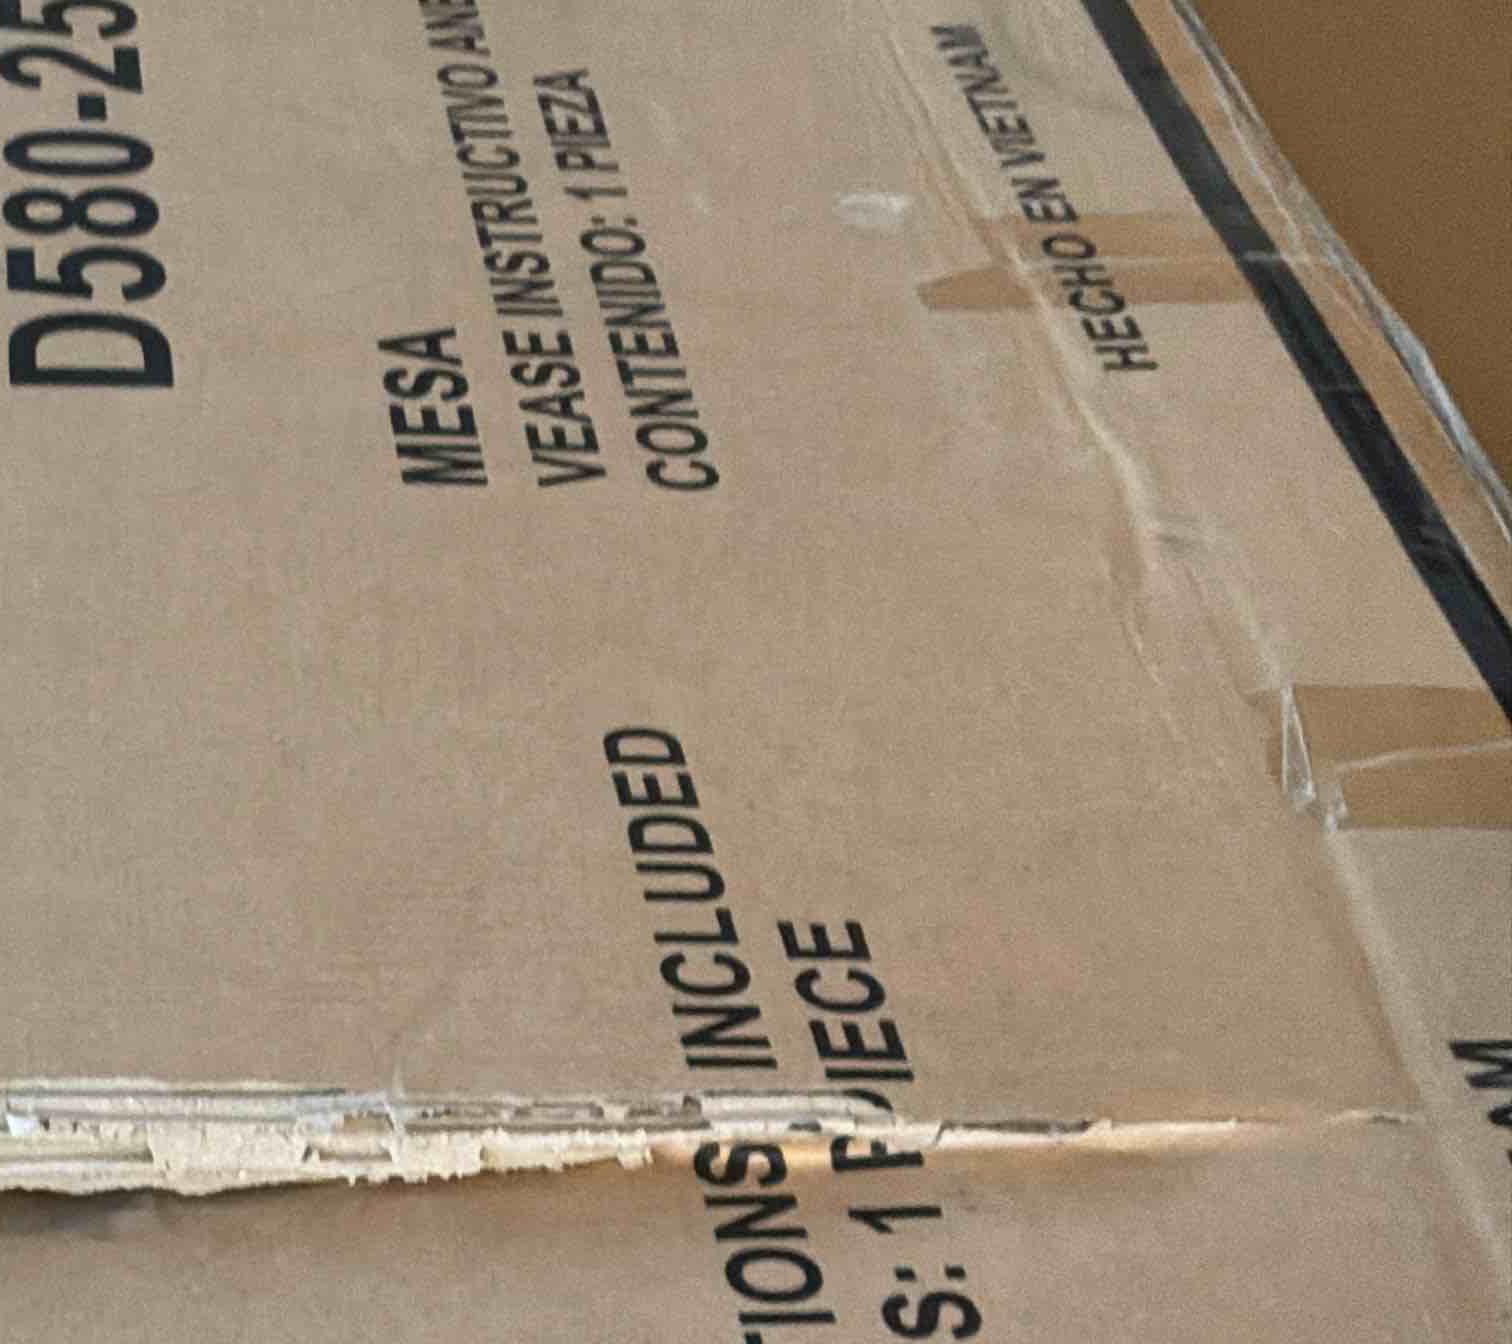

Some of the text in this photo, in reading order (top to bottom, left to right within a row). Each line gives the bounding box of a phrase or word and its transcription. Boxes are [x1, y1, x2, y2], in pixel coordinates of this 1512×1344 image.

[437, 63, 563, 317] INSTRUCTIVO
[532, 67, 720, 492] CONTENIDO: 1 PIEZA
[930, 23, 1160, 373] HECHO EN VIETNAM
[377, 326, 489, 487] MESA
[501, 329, 607, 488] VEASE
[602, 727, 779, 1070] INCLUDED
[777, 919, 926, 1174] PIECE
[847, 1204, 943, 1234] 1
